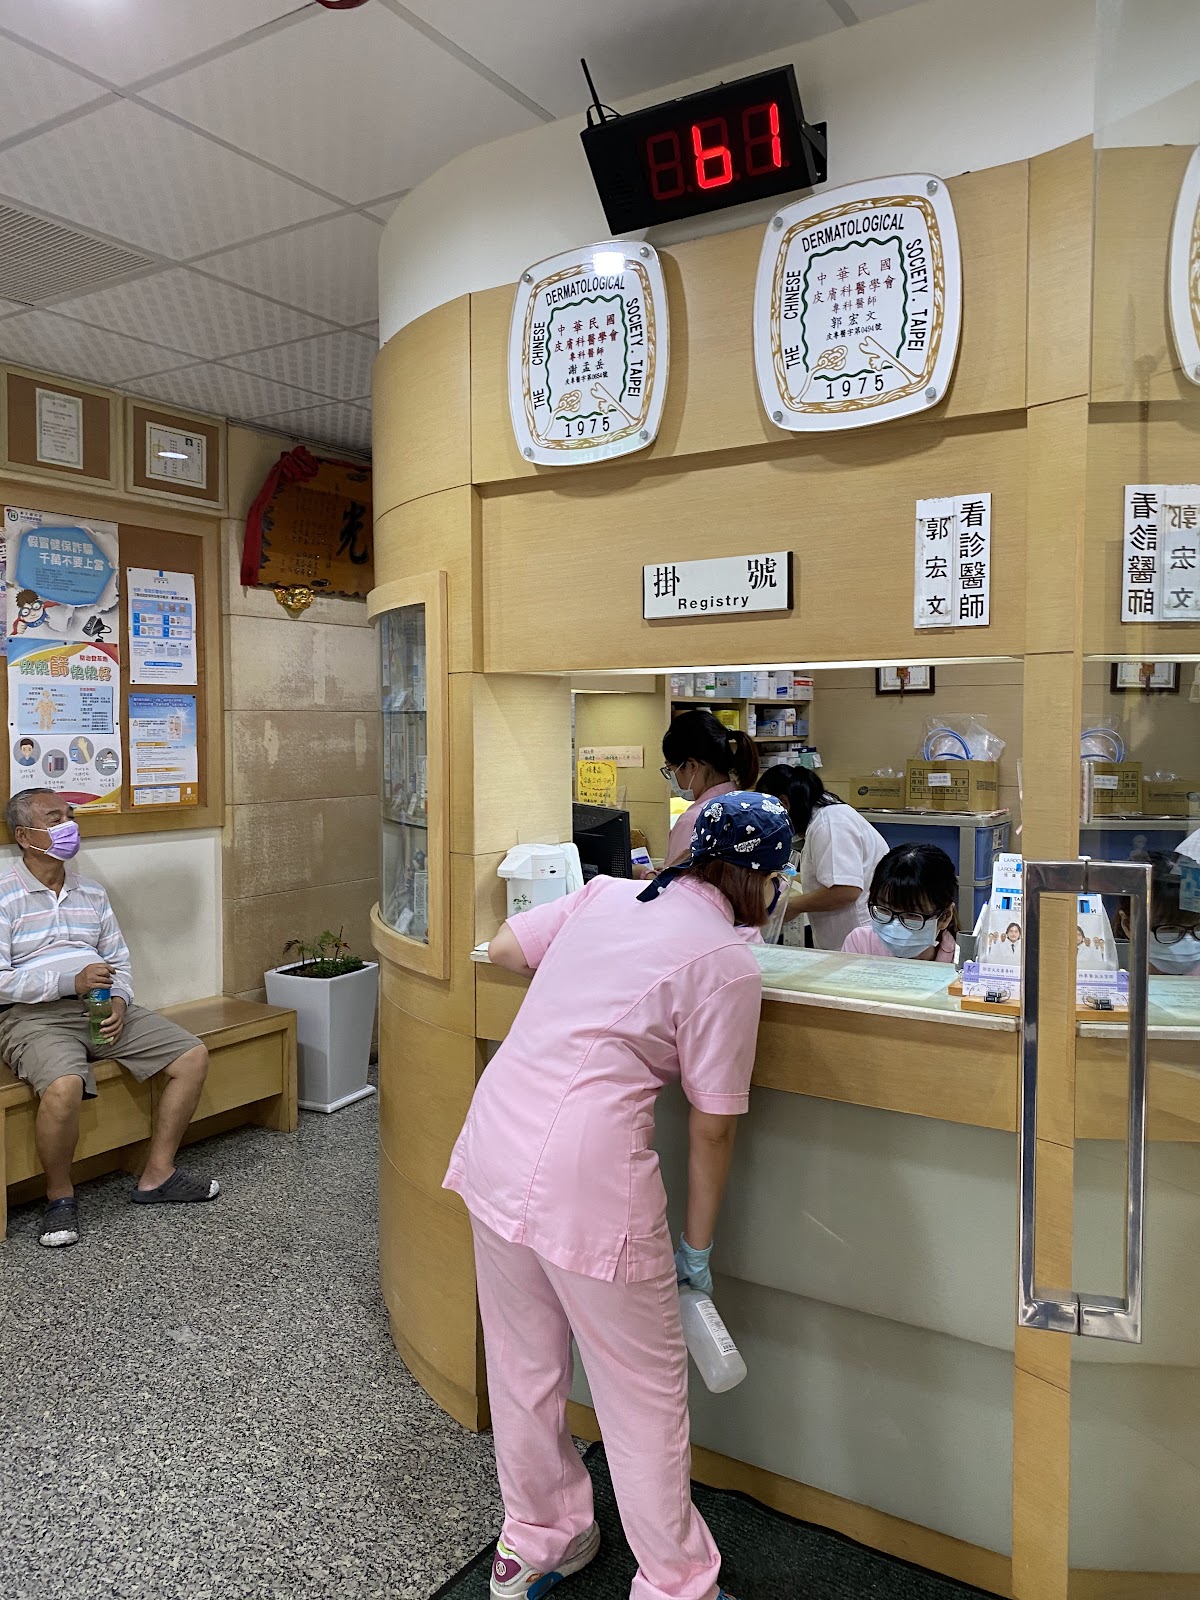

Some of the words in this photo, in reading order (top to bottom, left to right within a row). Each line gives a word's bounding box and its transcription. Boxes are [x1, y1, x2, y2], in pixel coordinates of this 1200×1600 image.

[802, 213, 905, 252] DERMATOLOGICAL
[818, 257, 892, 286] 中華民國
[906, 238, 928, 293] SOCIETY
[545, 275, 626, 306] DERMATOLOGICAL
[784, 270, 801, 320] CHINESE
[812, 275, 896, 305] 皮膚科醫學會
[831, 295, 877, 314] 專科醫師
[557, 313, 615, 337] 中華民國
[626, 297, 644, 346] SOCIETY
[830, 310, 877, 329] 郭宏文
[908, 309, 928, 351] TAIPEI
[532, 321, 546, 366] CHINESE
[554, 329, 619, 353] 皮膚科醫學會
[568, 346, 604, 362] 專科醫師
[786, 344, 800, 370] THE
[627, 359, 644, 397] TAIPEI
[826, 374, 884, 400] 1975
[534, 388, 545, 410] THE
[565, 416, 610, 438] 1975
[38, 552, 105, 572] 千萬不要上當
[925, 517, 948, 615] 郭宏文
[959, 500, 986, 620] 看診醫師
[653, 557, 777, 598] 掛號
[678, 595, 750, 610] Registry
